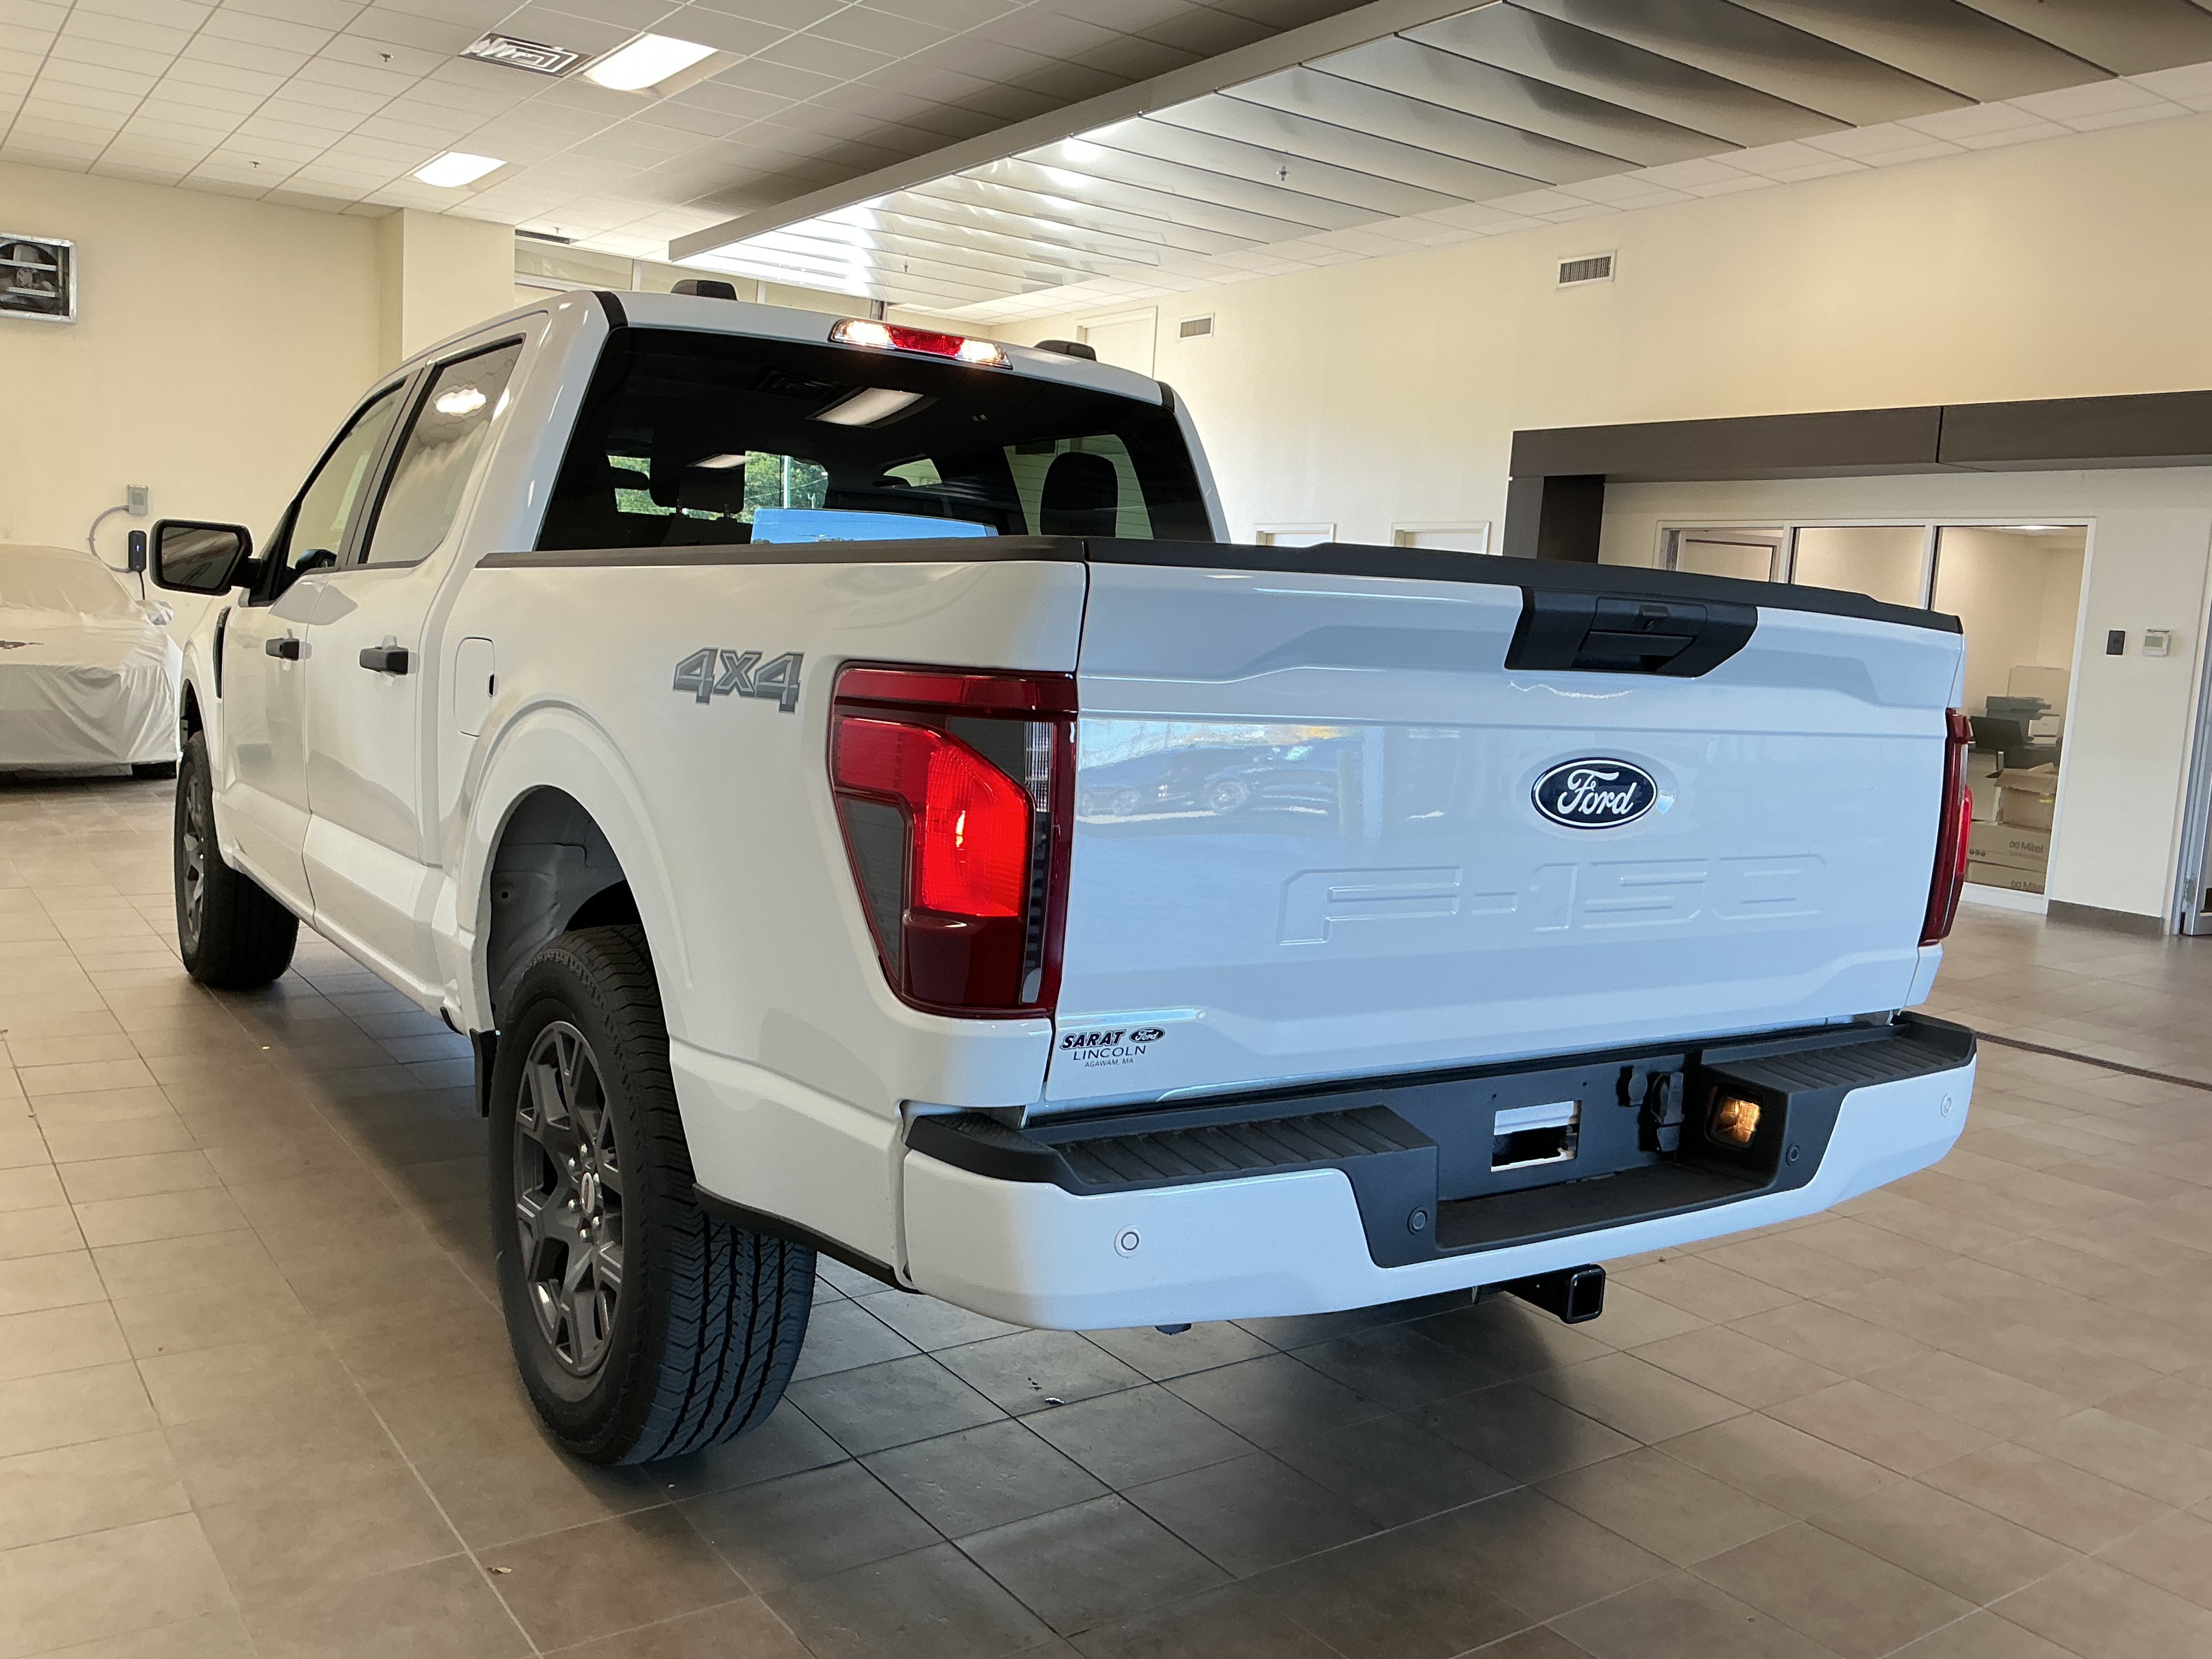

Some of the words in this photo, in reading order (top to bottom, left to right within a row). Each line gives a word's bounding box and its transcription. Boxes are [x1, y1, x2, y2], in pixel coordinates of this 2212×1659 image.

[1557, 769, 1638, 815] Ford
[2021, 842, 2044, 853] Mitel
[2023, 881, 2044, 891] Mite
[1278, 854, 1827, 946] F-150
[1060, 1029, 1126, 1049] SARAT
[1135, 1030, 1159, 1041] Ford
[1073, 1045, 1146, 1060] LINCOLN
[1084, 1059, 1120, 1068] AGAWAM,
